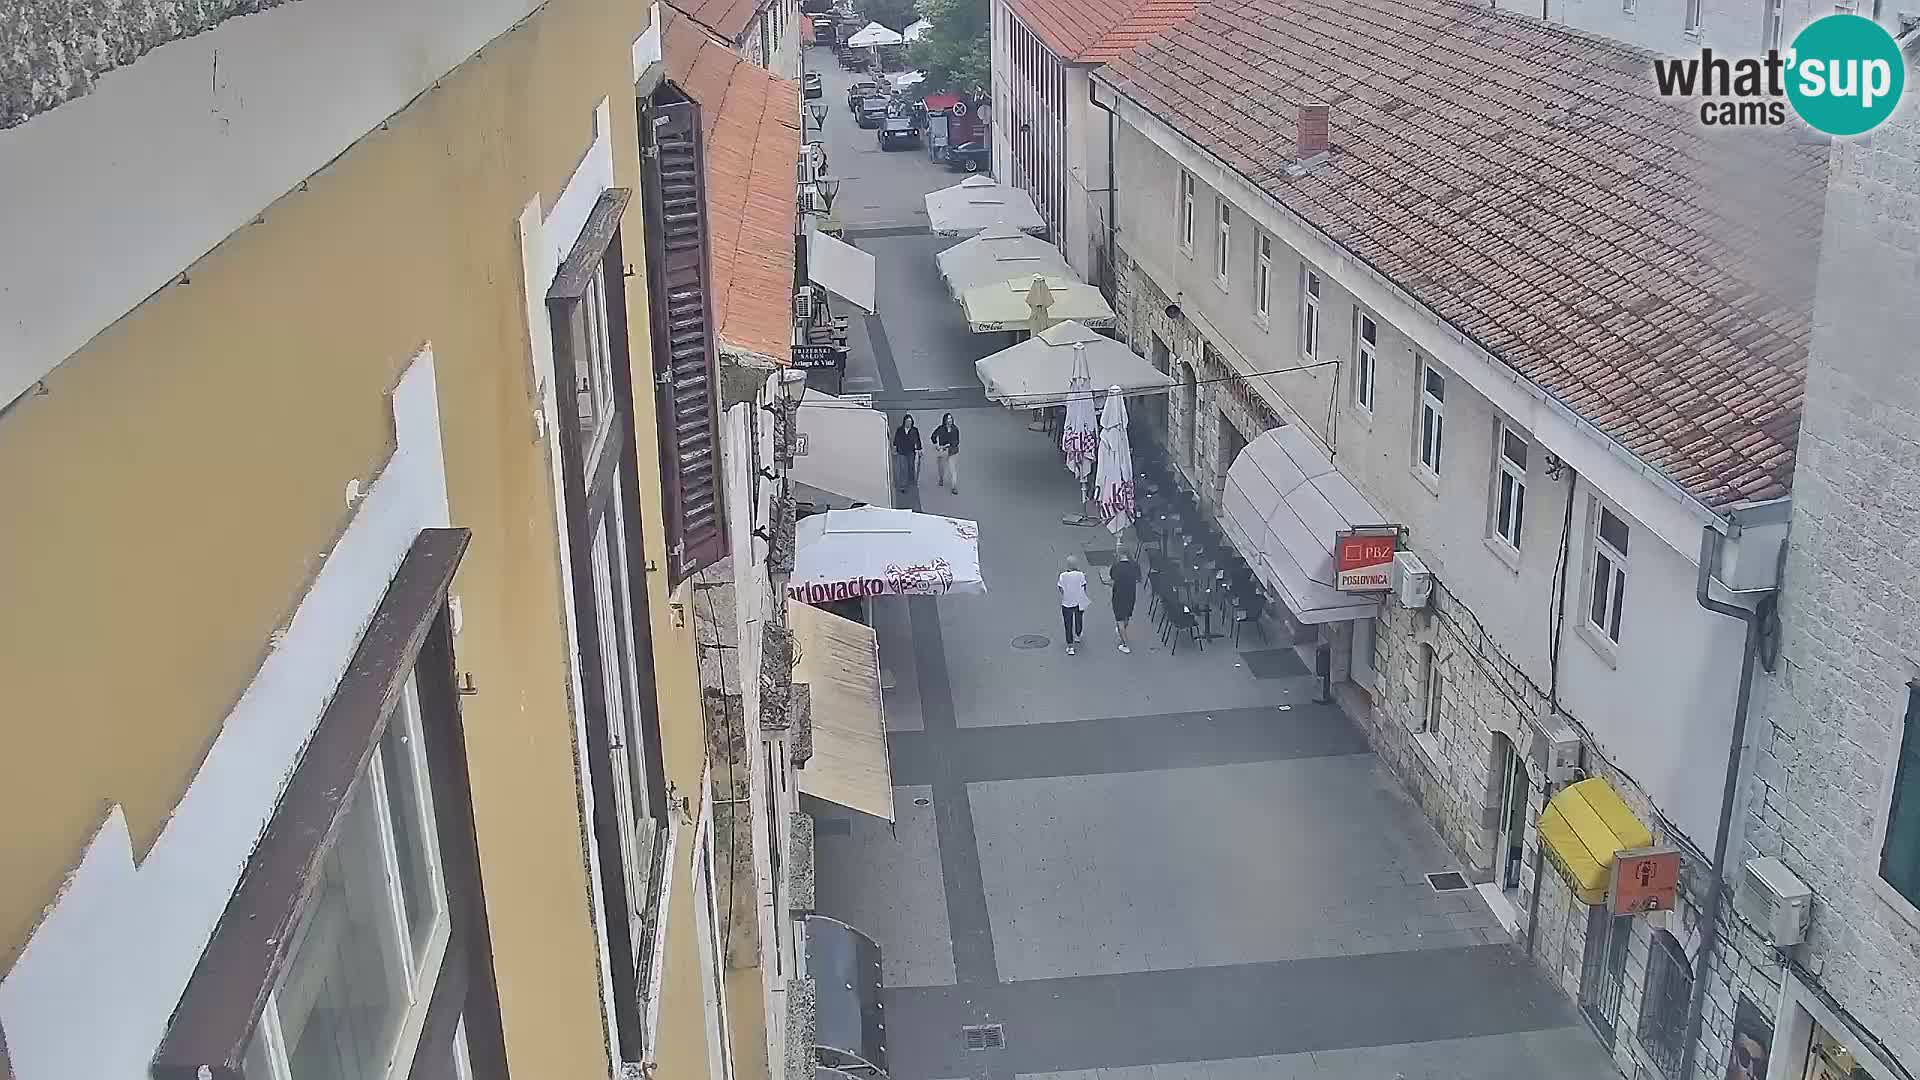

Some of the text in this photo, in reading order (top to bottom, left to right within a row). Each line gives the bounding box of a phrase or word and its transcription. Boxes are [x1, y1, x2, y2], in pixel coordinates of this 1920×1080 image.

[1365, 546, 1390, 559] PBZ
[1342, 574, 1388, 586] POSLOVNICA
[786, 576, 884, 604] arlovačko
